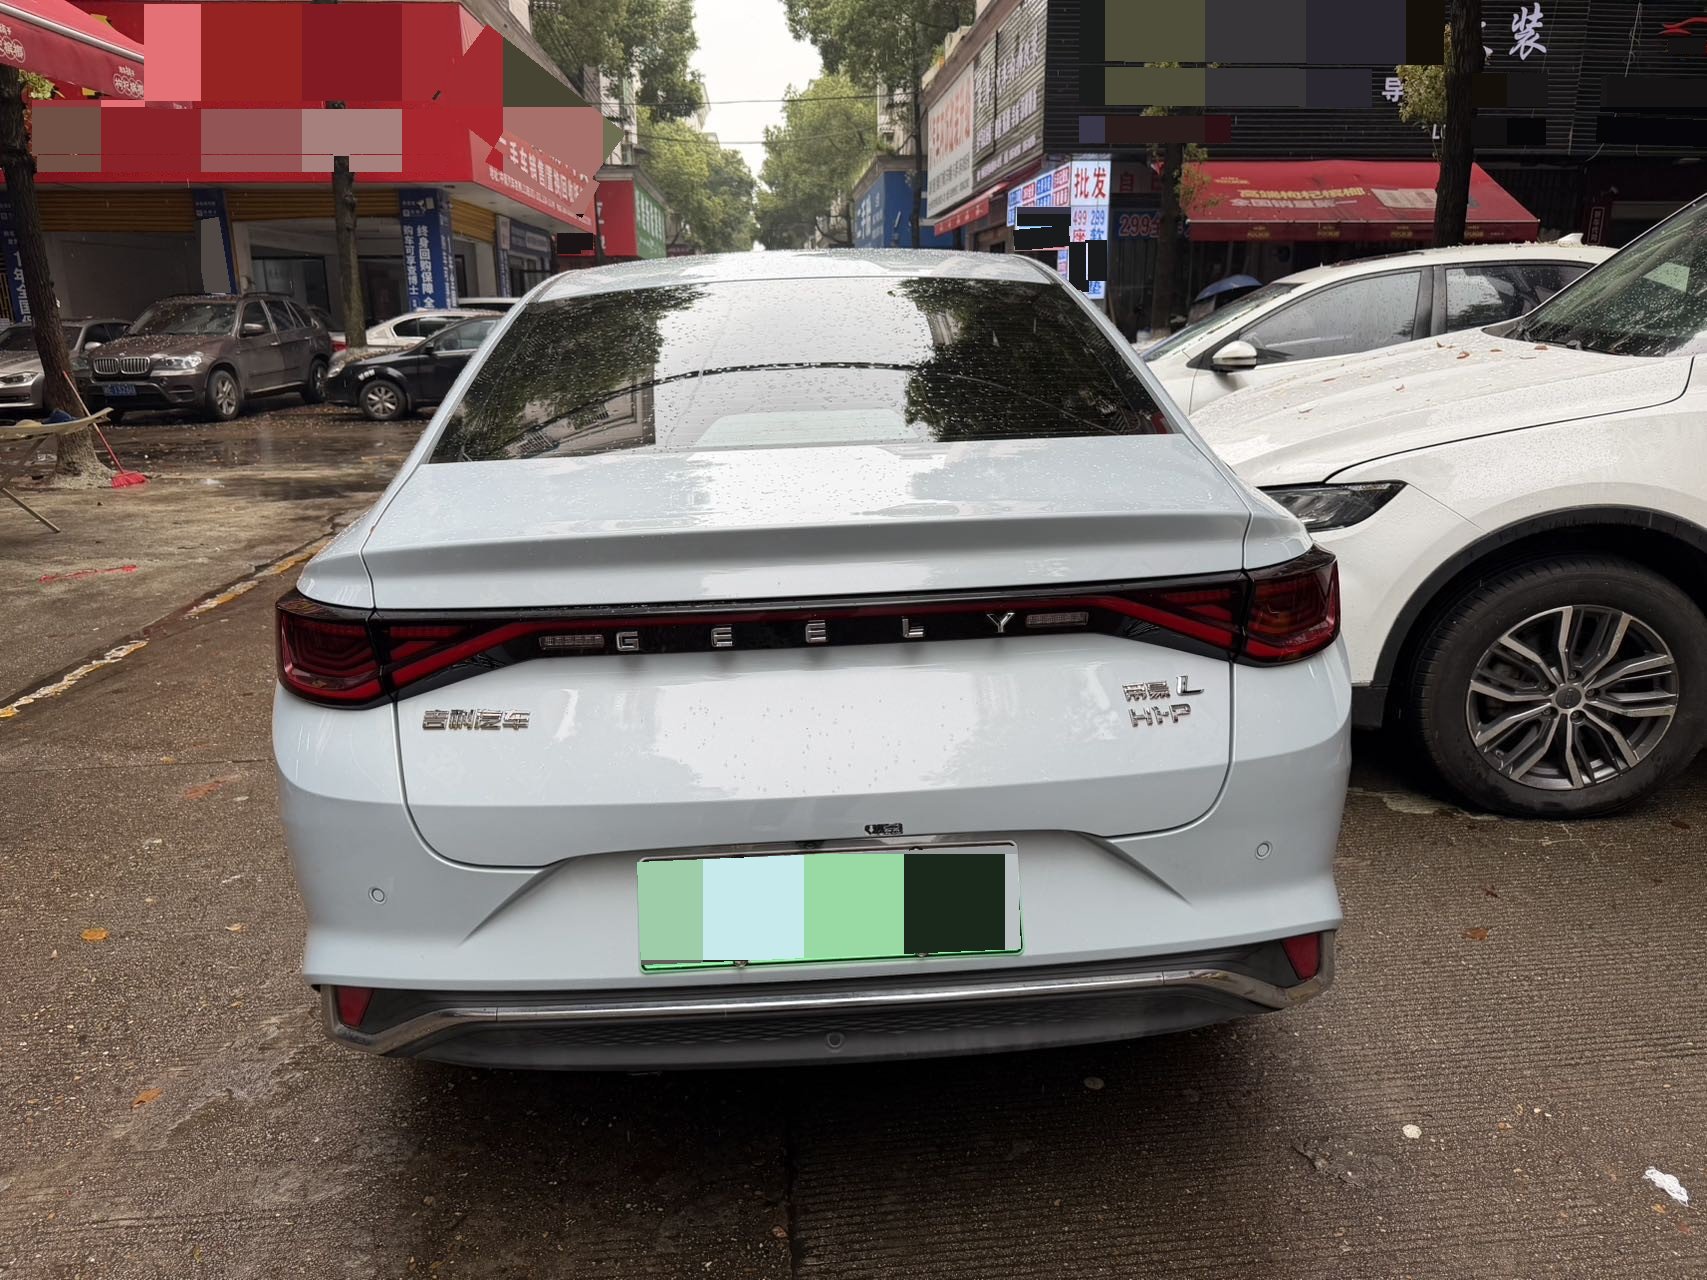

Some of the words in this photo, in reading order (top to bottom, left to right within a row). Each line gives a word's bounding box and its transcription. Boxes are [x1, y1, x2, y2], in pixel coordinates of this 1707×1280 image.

[1074, 167, 1107, 199] 批发
[616, 612, 1016, 651] GEELY
[422, 709, 531, 731] 吉利汽车
